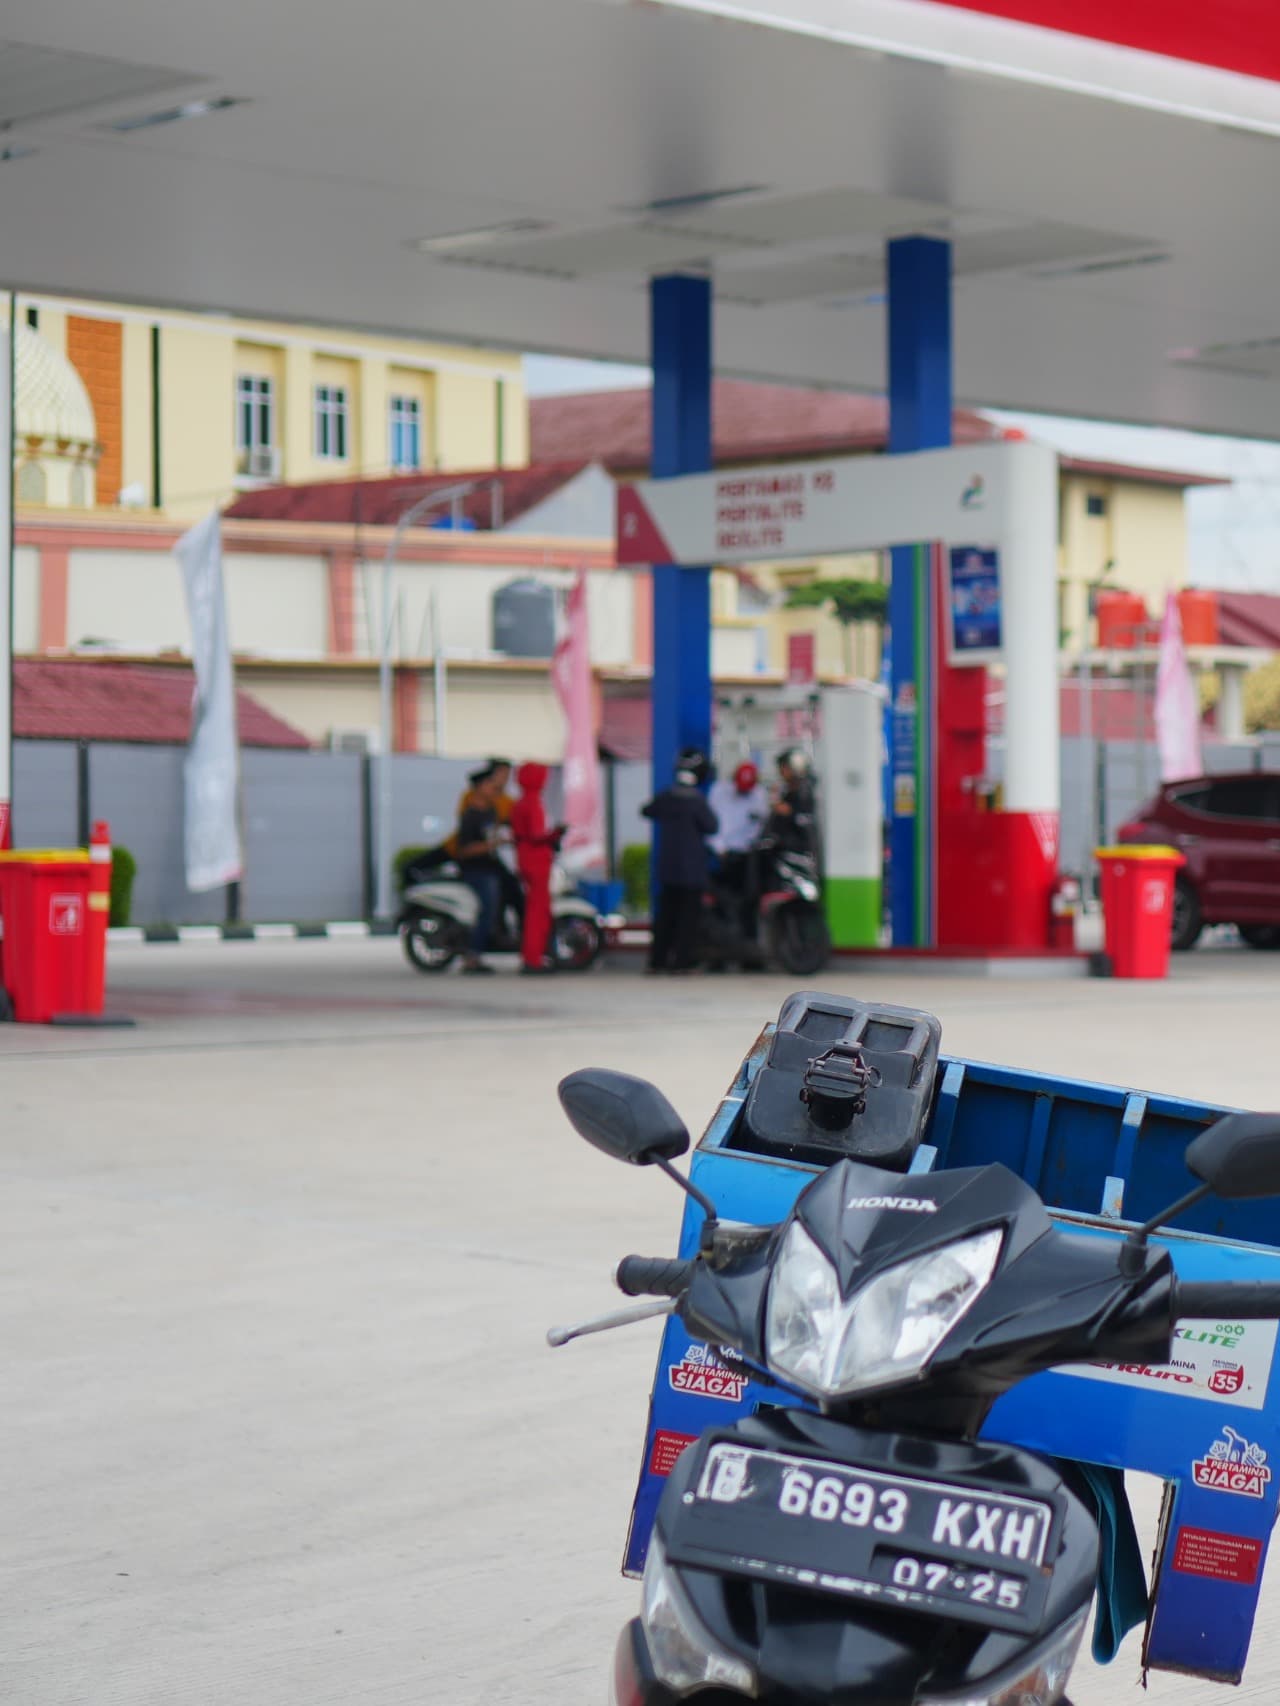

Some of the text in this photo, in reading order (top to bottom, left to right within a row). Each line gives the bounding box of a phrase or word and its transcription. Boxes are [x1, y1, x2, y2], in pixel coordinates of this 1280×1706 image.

[848, 1197, 937, 1213] HONDA
[688, 1365, 742, 1380] PERTAMINA
[674, 1371, 737, 1396] SIAGA
[1211, 1461, 1266, 1477] PERTAMINA
[1197, 1467, 1260, 1493] SIAGA
[778, 1470, 908, 1534] 6693
[932, 1499, 1037, 1560] KXH
